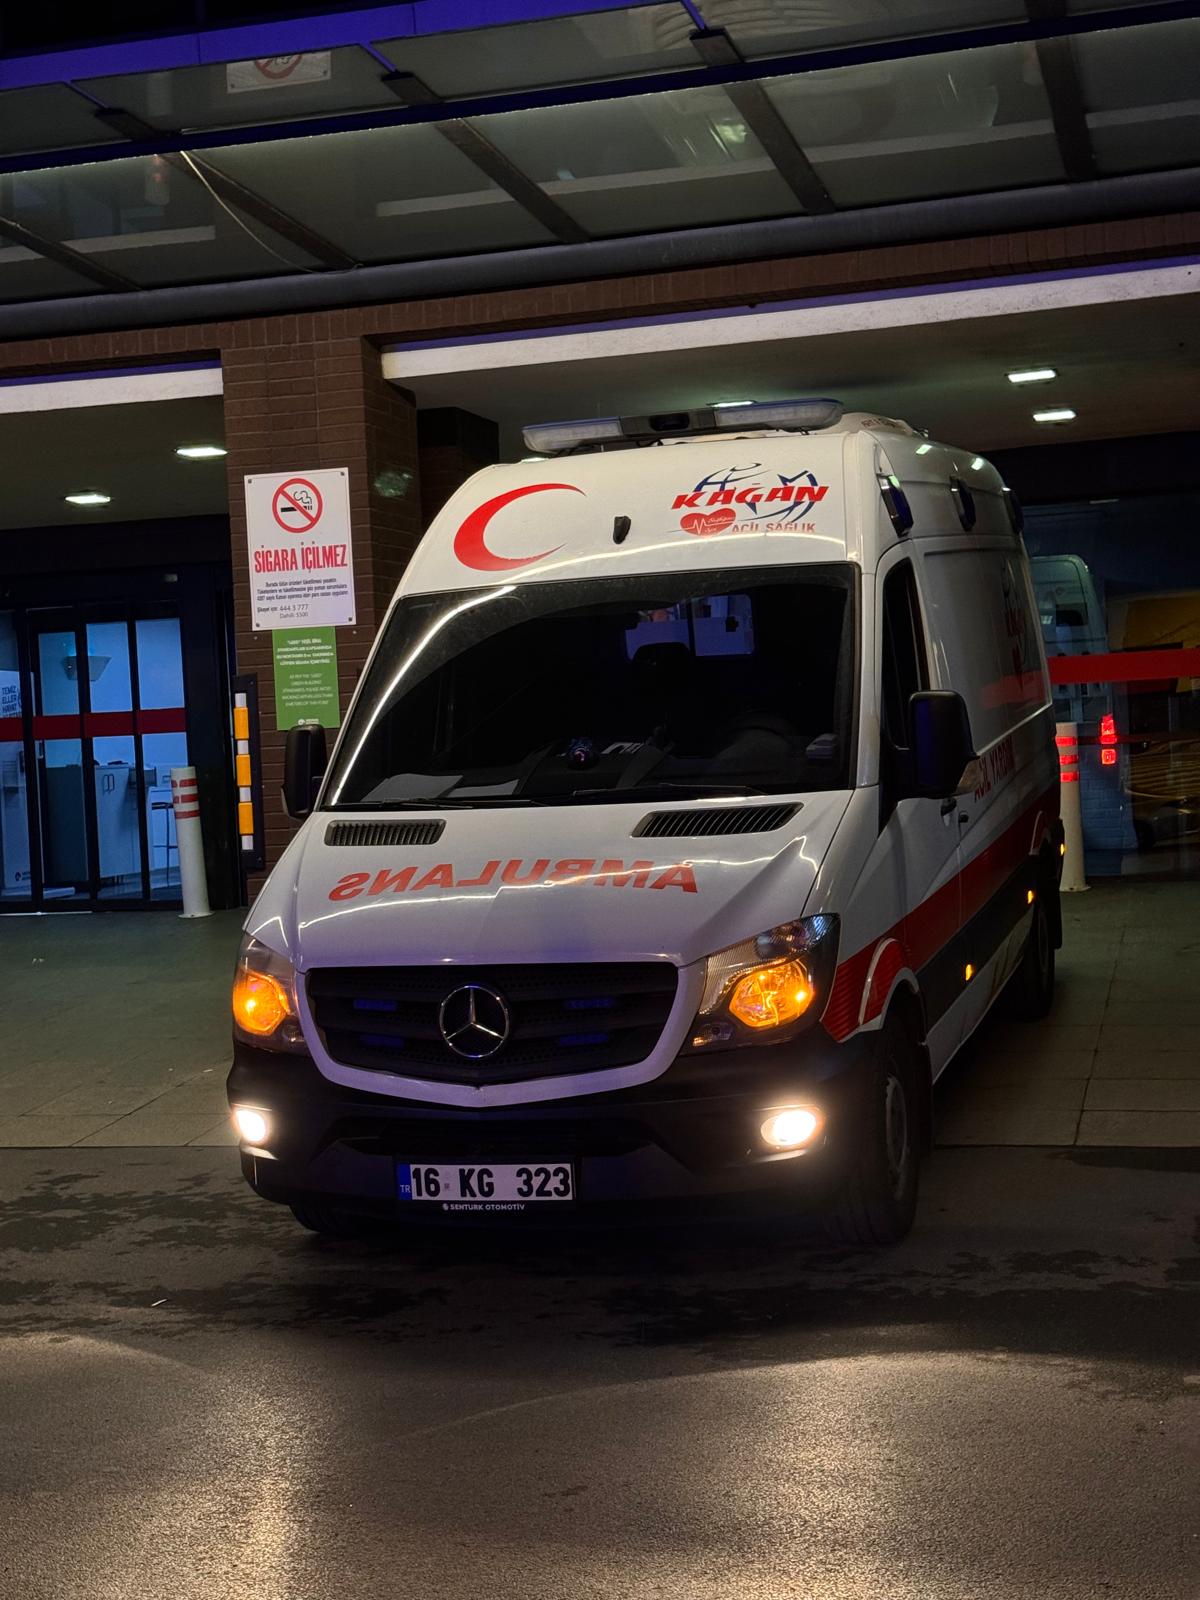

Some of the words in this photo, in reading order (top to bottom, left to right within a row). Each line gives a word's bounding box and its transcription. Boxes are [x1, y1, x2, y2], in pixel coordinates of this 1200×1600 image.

[254, 545, 298, 573] SİGARA
[300, 541, 348, 573] İÇİLMEZ
[400, 1184, 411, 1193] TR
[412, 1167, 441, 1198] 16
[459, 1167, 495, 1198] KG
[516, 1166, 571, 1198] 323
